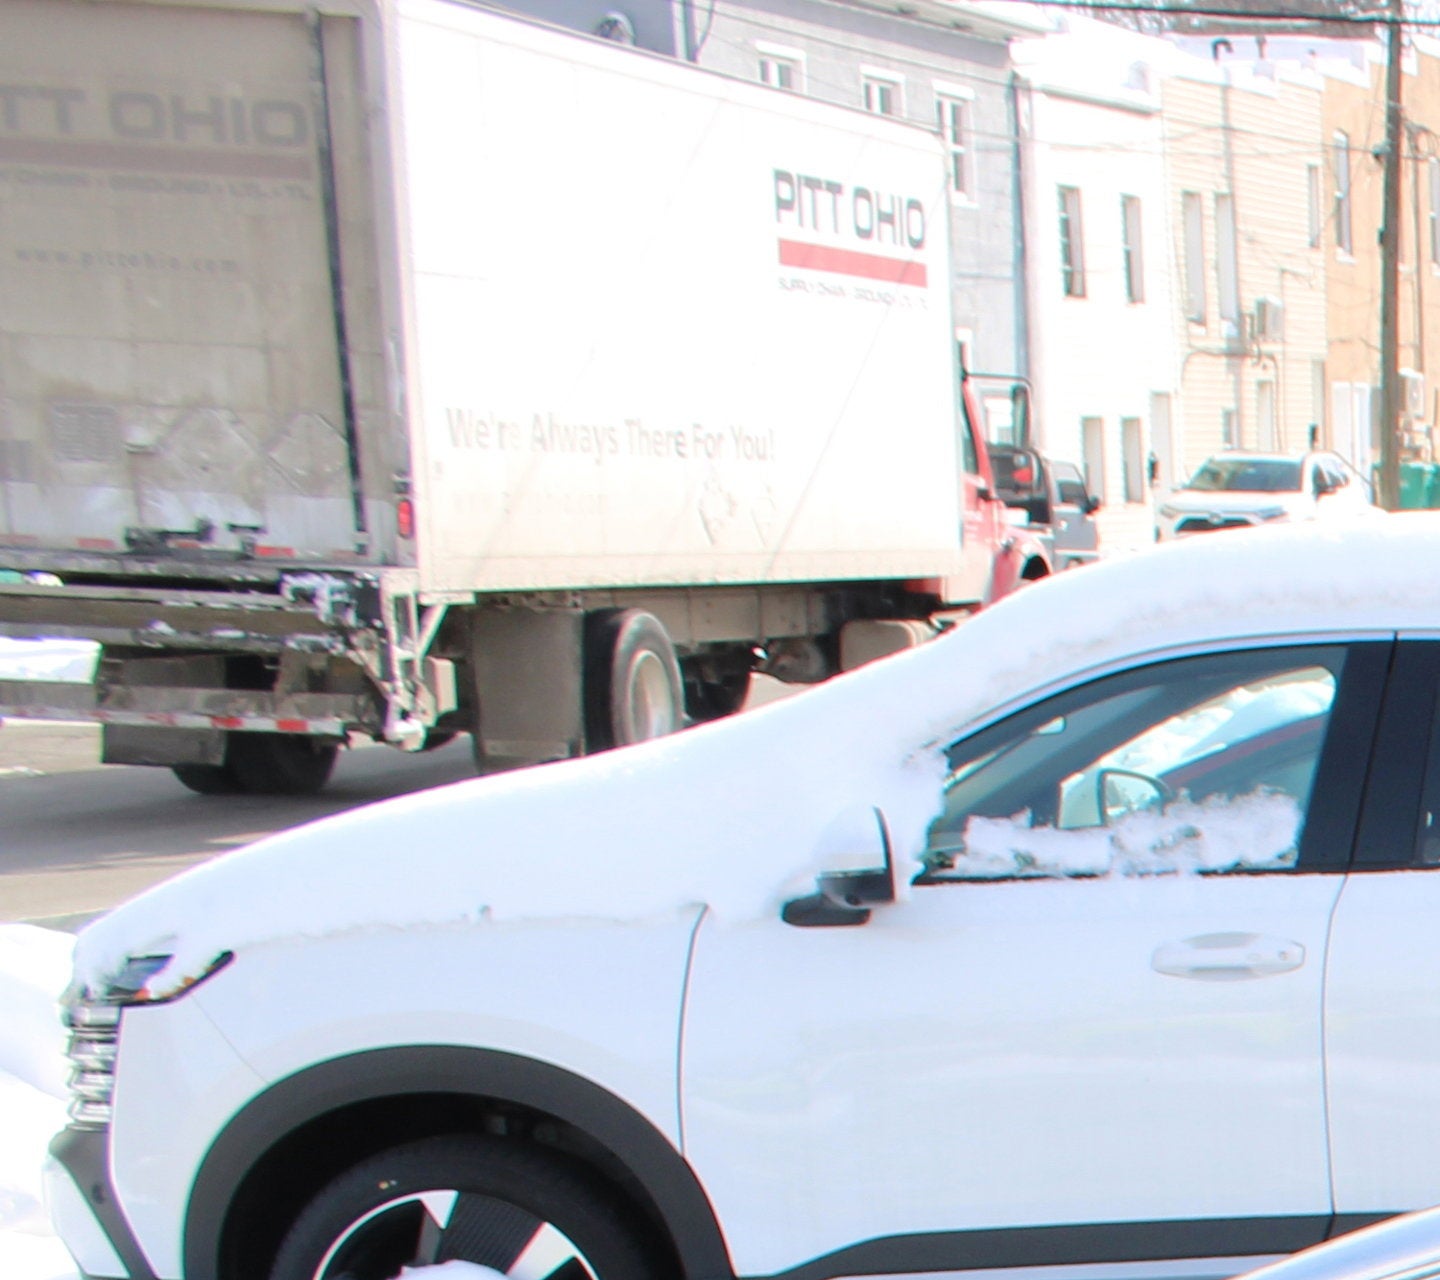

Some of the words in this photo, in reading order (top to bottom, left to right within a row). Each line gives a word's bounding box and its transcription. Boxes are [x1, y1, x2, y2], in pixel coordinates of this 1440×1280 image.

[0, 83, 87, 133] TT
[107, 90, 308, 146] OHIO
[772, 166, 845, 235] PITT
[852, 186, 926, 250] OHIO
[444, 406, 522, 451] We're
[528, 410, 619, 466] Always
[623, 418, 689, 461] There
[692, 422, 724, 460] For
[729, 424, 776, 464] You!
